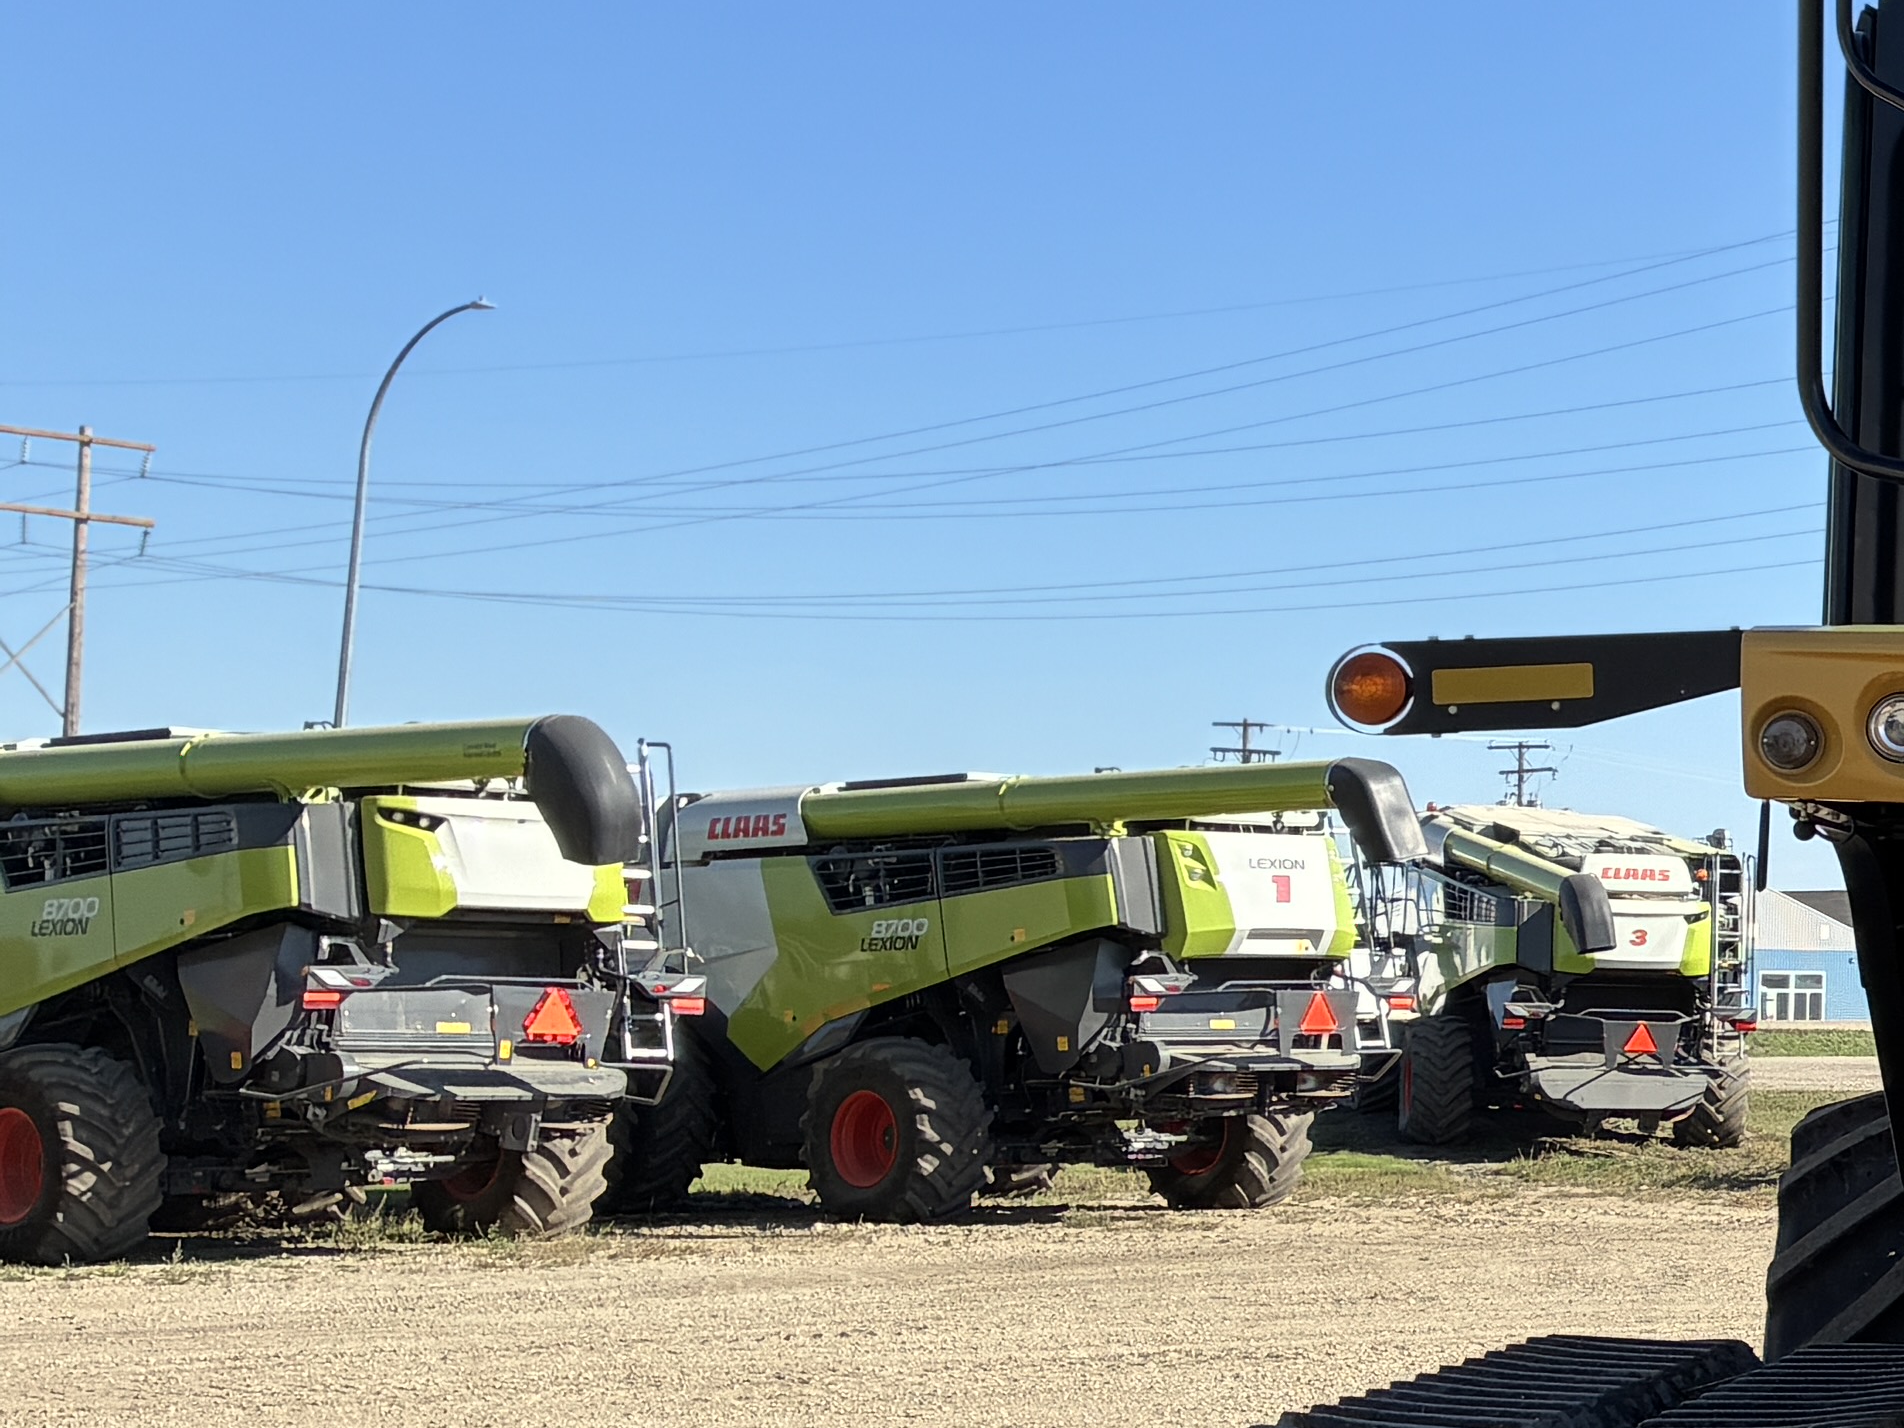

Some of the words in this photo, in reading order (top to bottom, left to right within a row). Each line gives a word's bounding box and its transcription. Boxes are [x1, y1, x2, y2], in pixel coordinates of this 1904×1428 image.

[707, 813, 787, 840] CLAAS
[1248, 858, 1305, 870] LEXION
[1601, 867, 1671, 881] CLAAS
[1271, 875, 1290, 903] 1
[43, 897, 99, 920] 8700
[31, 917, 90, 937] LEXION
[871, 918, 928, 938] 8700
[860, 935, 920, 952] LEXION
[1629, 929, 1648, 946] 3
